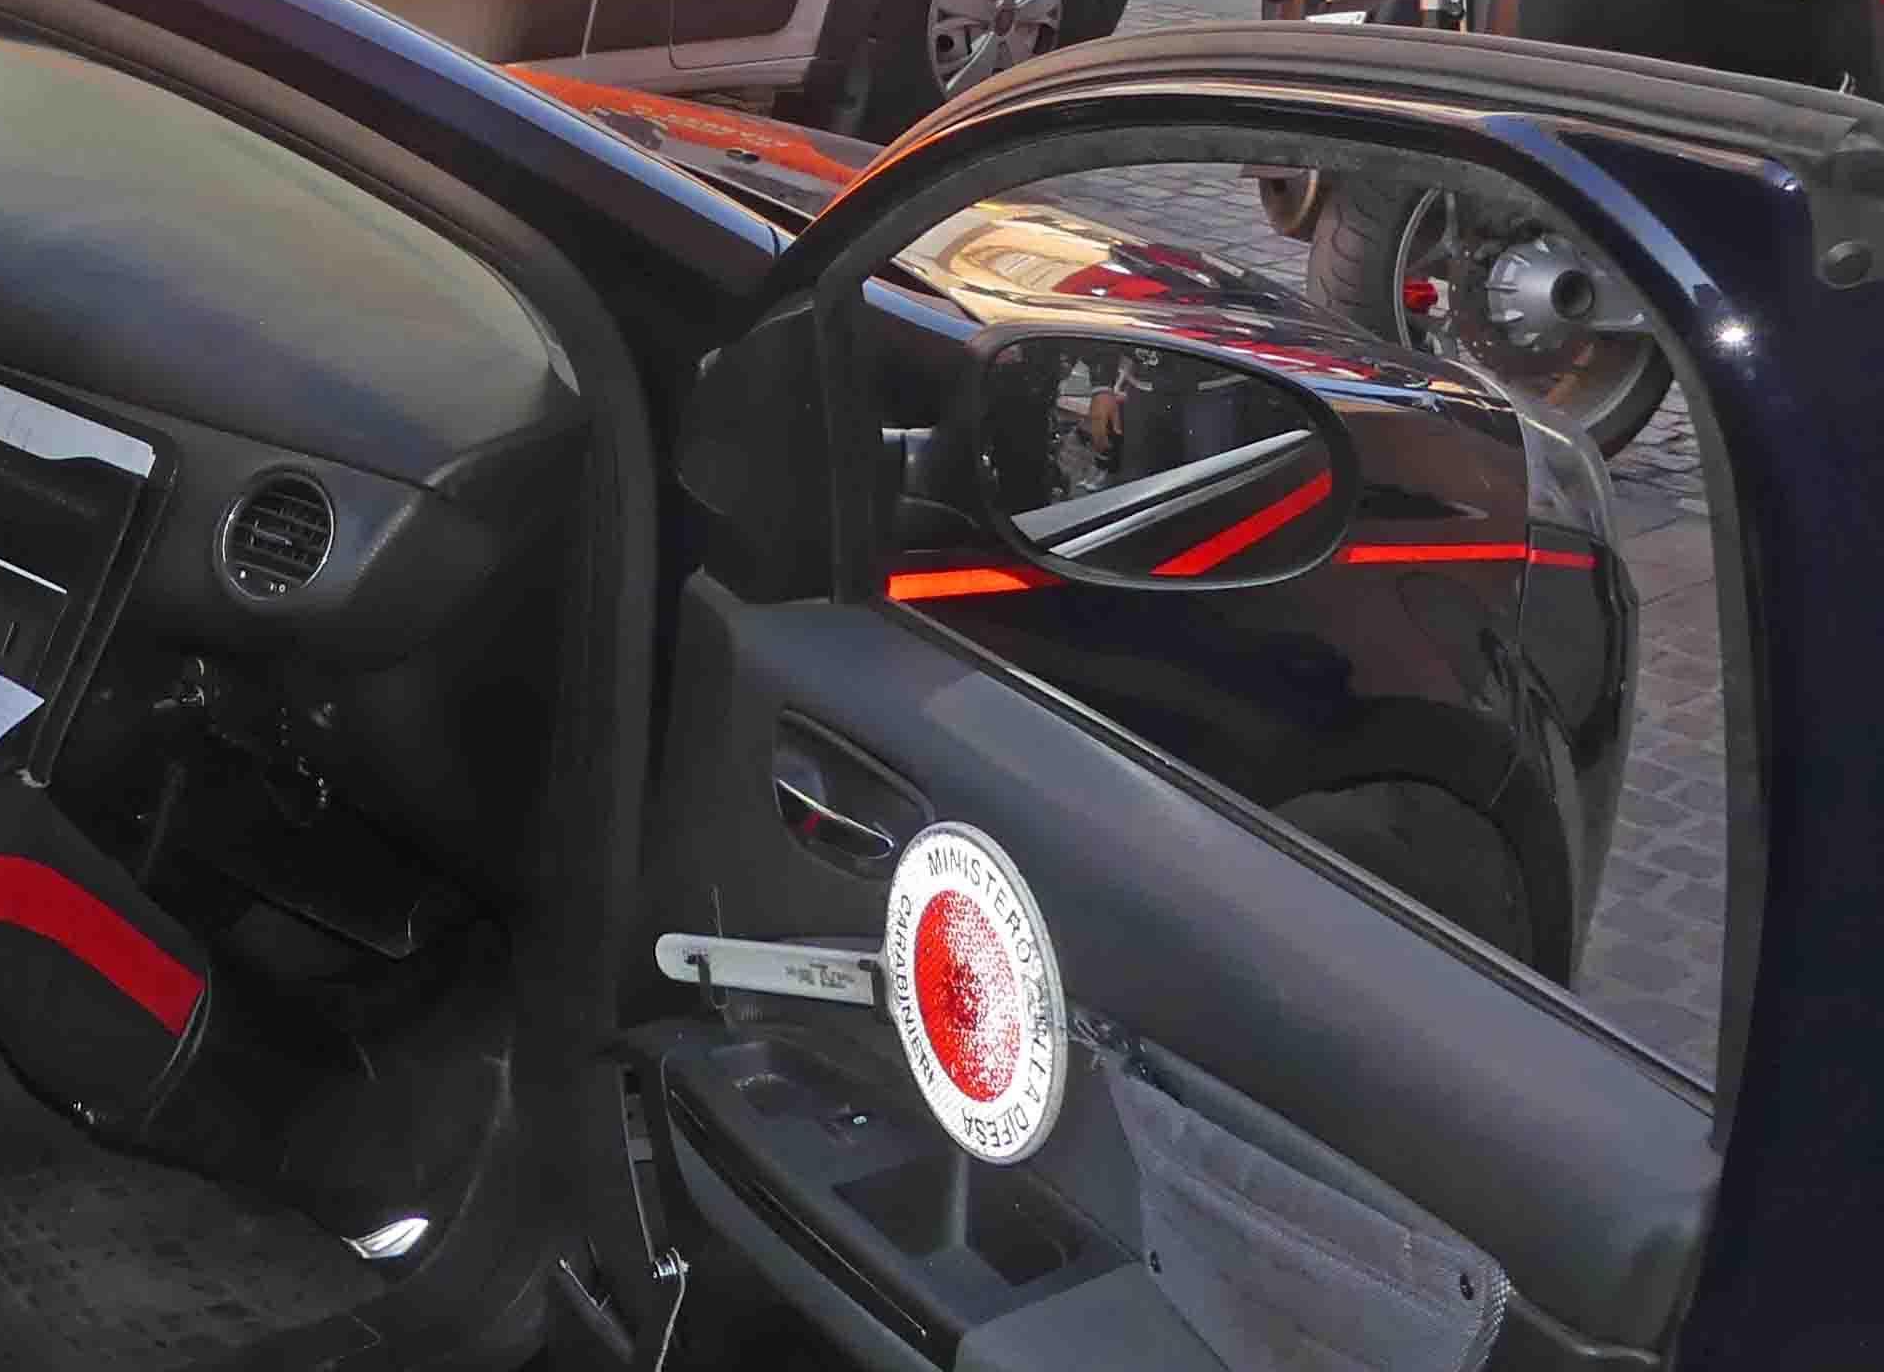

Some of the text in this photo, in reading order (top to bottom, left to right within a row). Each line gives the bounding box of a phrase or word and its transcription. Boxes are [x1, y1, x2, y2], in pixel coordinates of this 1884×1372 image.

[927, 847, 1034, 963] MINISTERO
[892, 893, 936, 1085] CARABINIERI
[961, 1105, 1030, 1148] DIFESA
